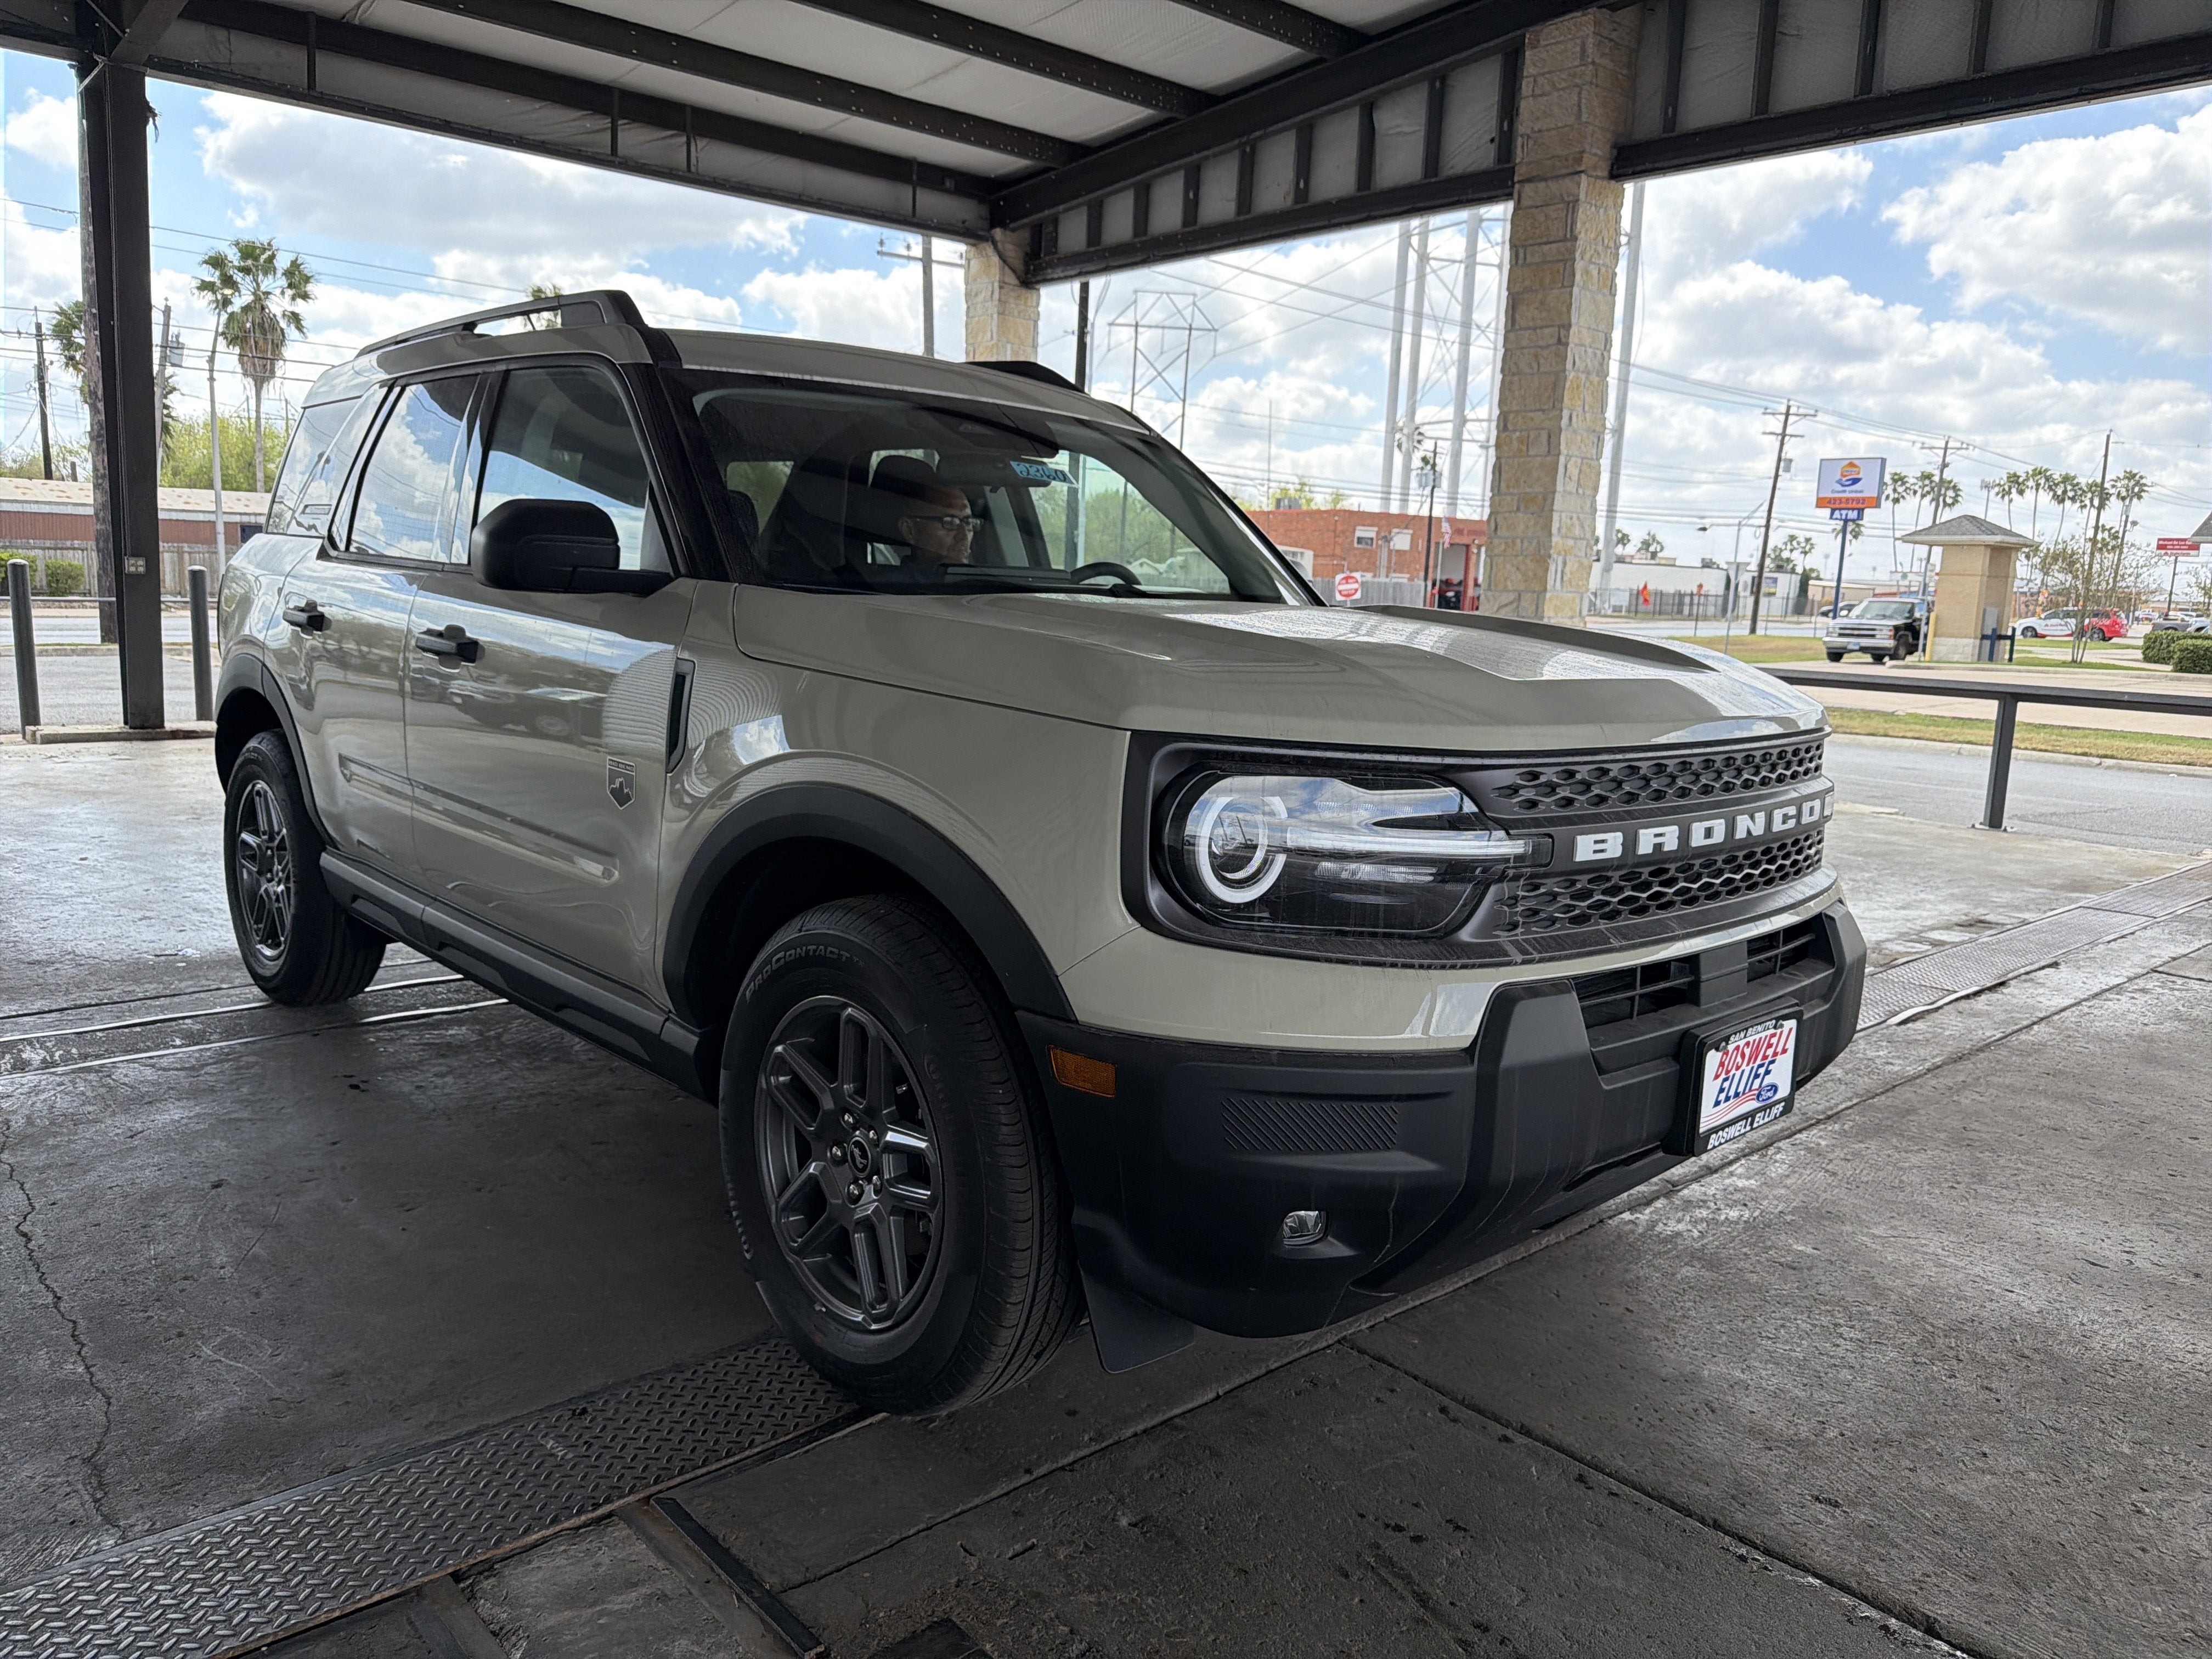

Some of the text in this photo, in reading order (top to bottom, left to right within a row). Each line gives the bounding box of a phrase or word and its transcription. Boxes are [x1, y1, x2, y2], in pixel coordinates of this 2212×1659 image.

[1832, 509, 1858, 520] ATM
[1573, 799, 1820, 861] BRONCO
[1712, 1027, 1793, 1082] BOSWELL
[1729, 1020, 1776, 1044] SAN BENITO
[1712, 1059, 1777, 1109] ELLIFF
[1759, 1086, 1775, 1101] Ford
[1707, 1102, 1785, 1150] BOSWELL ELLIFF
